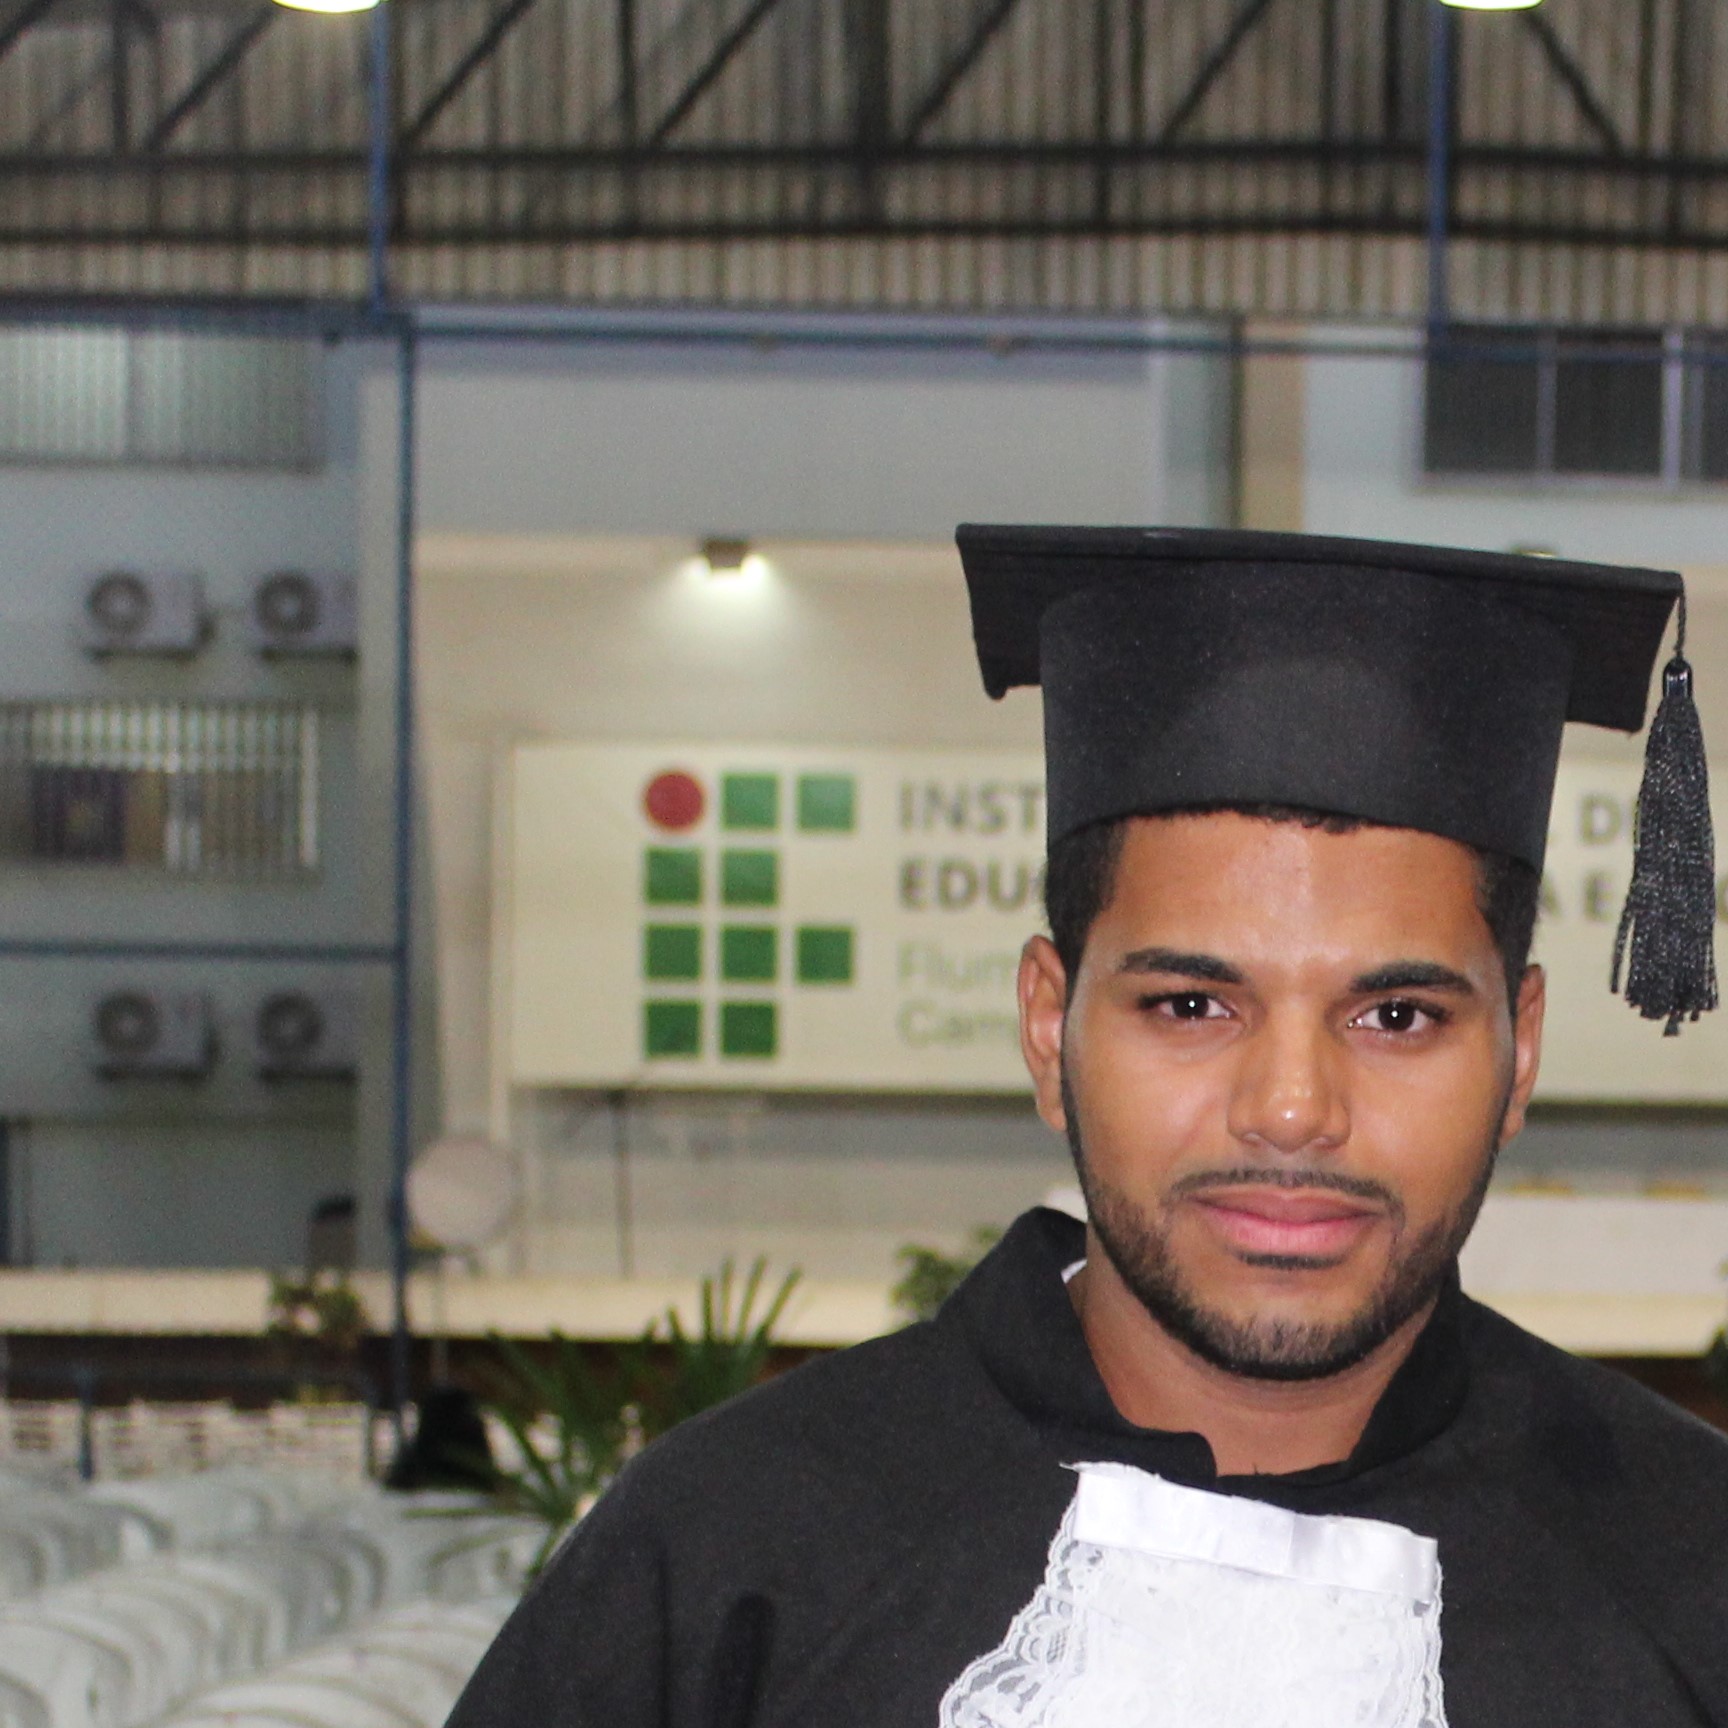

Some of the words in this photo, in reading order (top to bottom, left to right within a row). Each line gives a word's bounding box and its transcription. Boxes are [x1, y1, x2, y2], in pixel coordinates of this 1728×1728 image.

[898, 780, 1042, 833] INST
[897, 857, 1045, 914] EDU
[898, 942, 1020, 990] Flum
[896, 998, 1020, 1049] Cam
